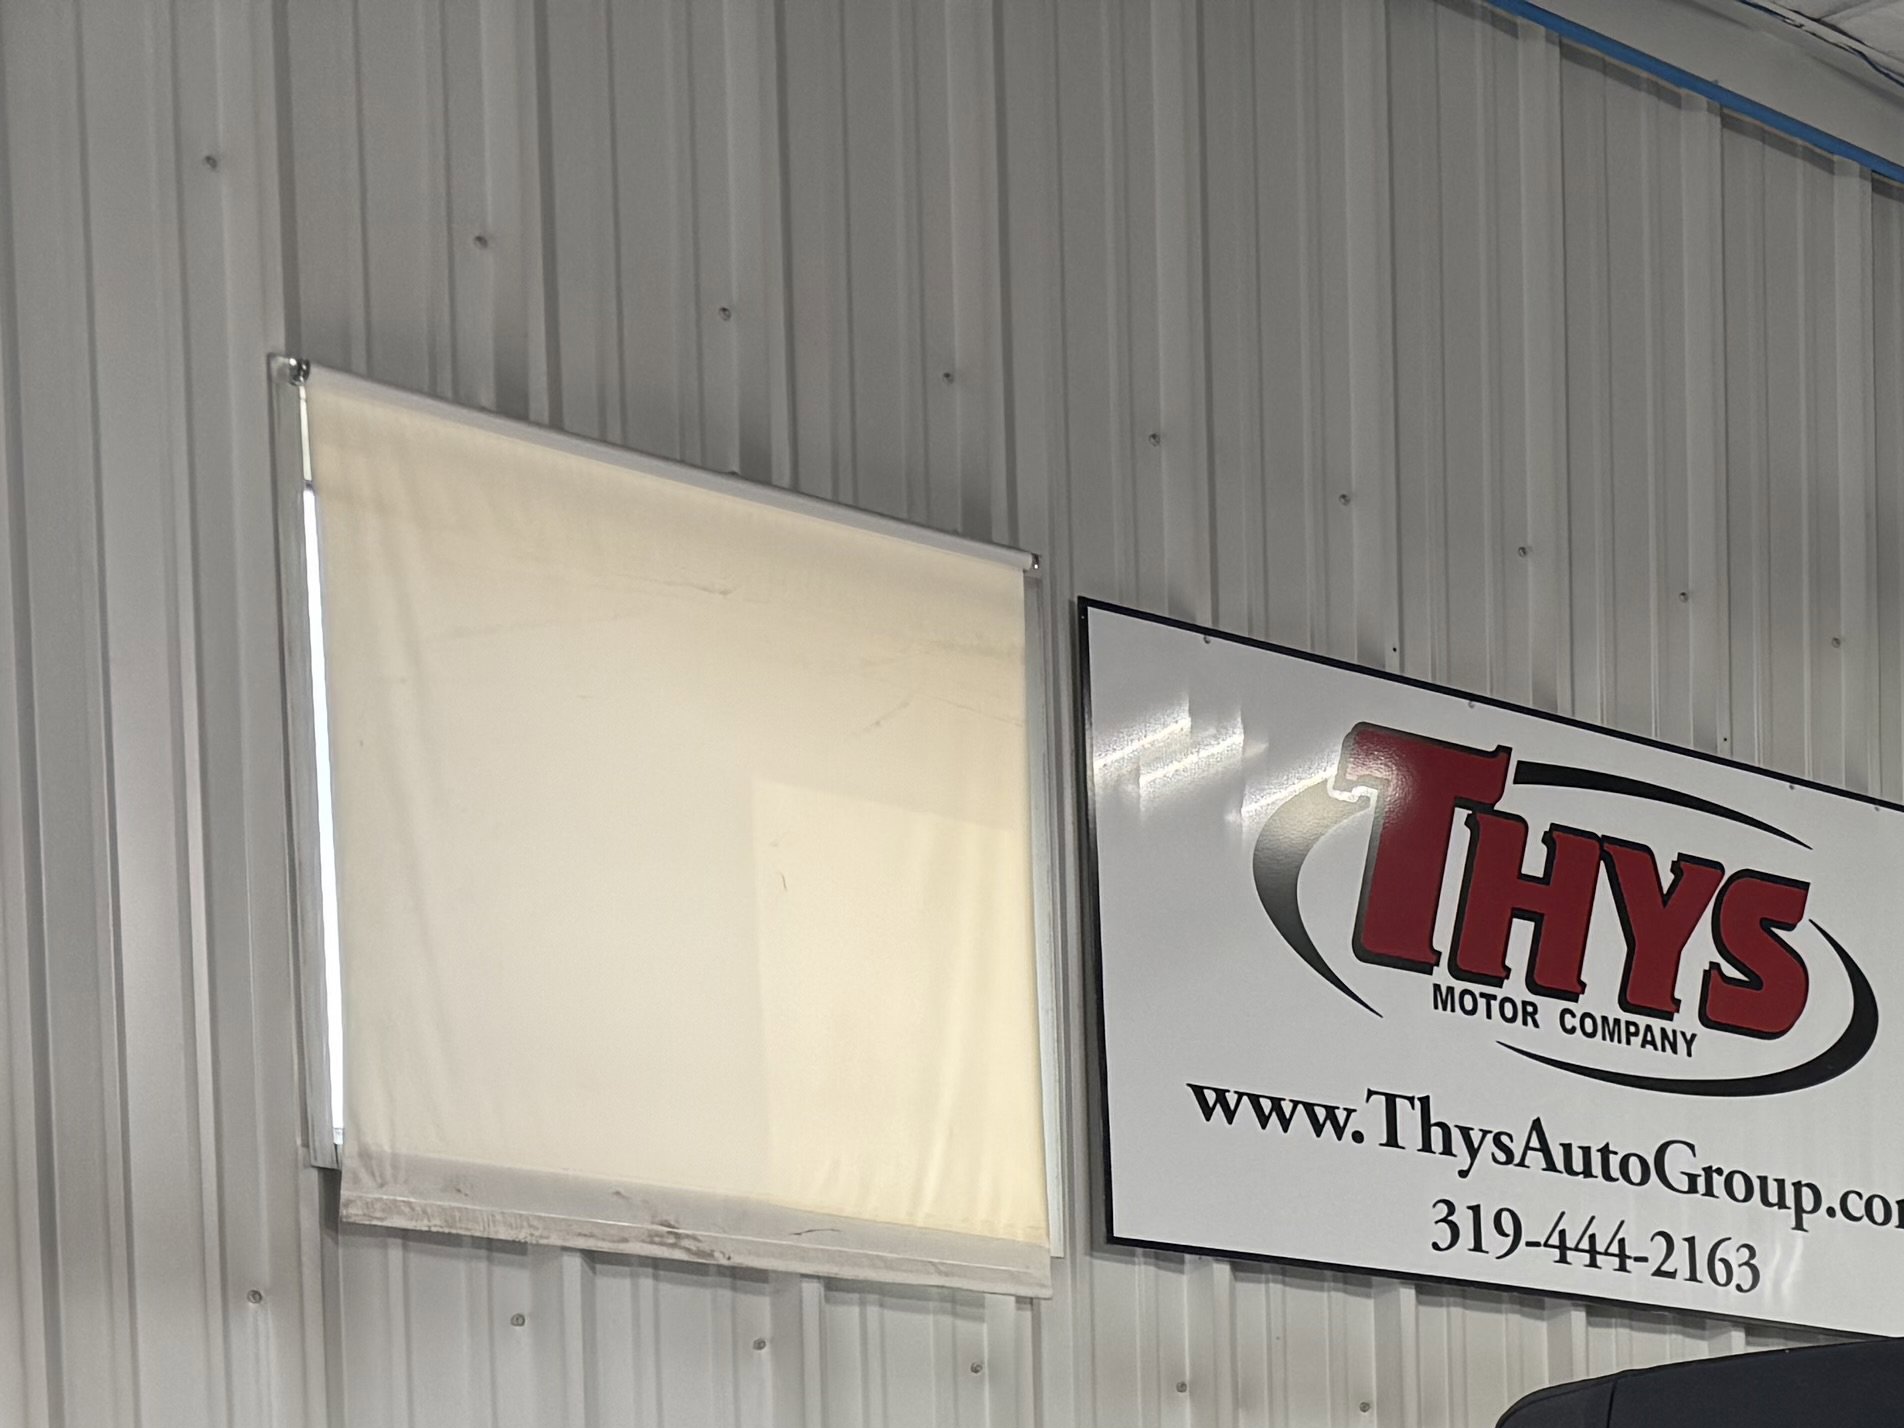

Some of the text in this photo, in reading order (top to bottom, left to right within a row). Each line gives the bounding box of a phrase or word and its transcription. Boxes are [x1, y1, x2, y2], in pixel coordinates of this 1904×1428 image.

[1431, 983, 1698, 1059] MOTOR COMPANY
[1429, 1198, 1763, 1295] 319-444-2163
